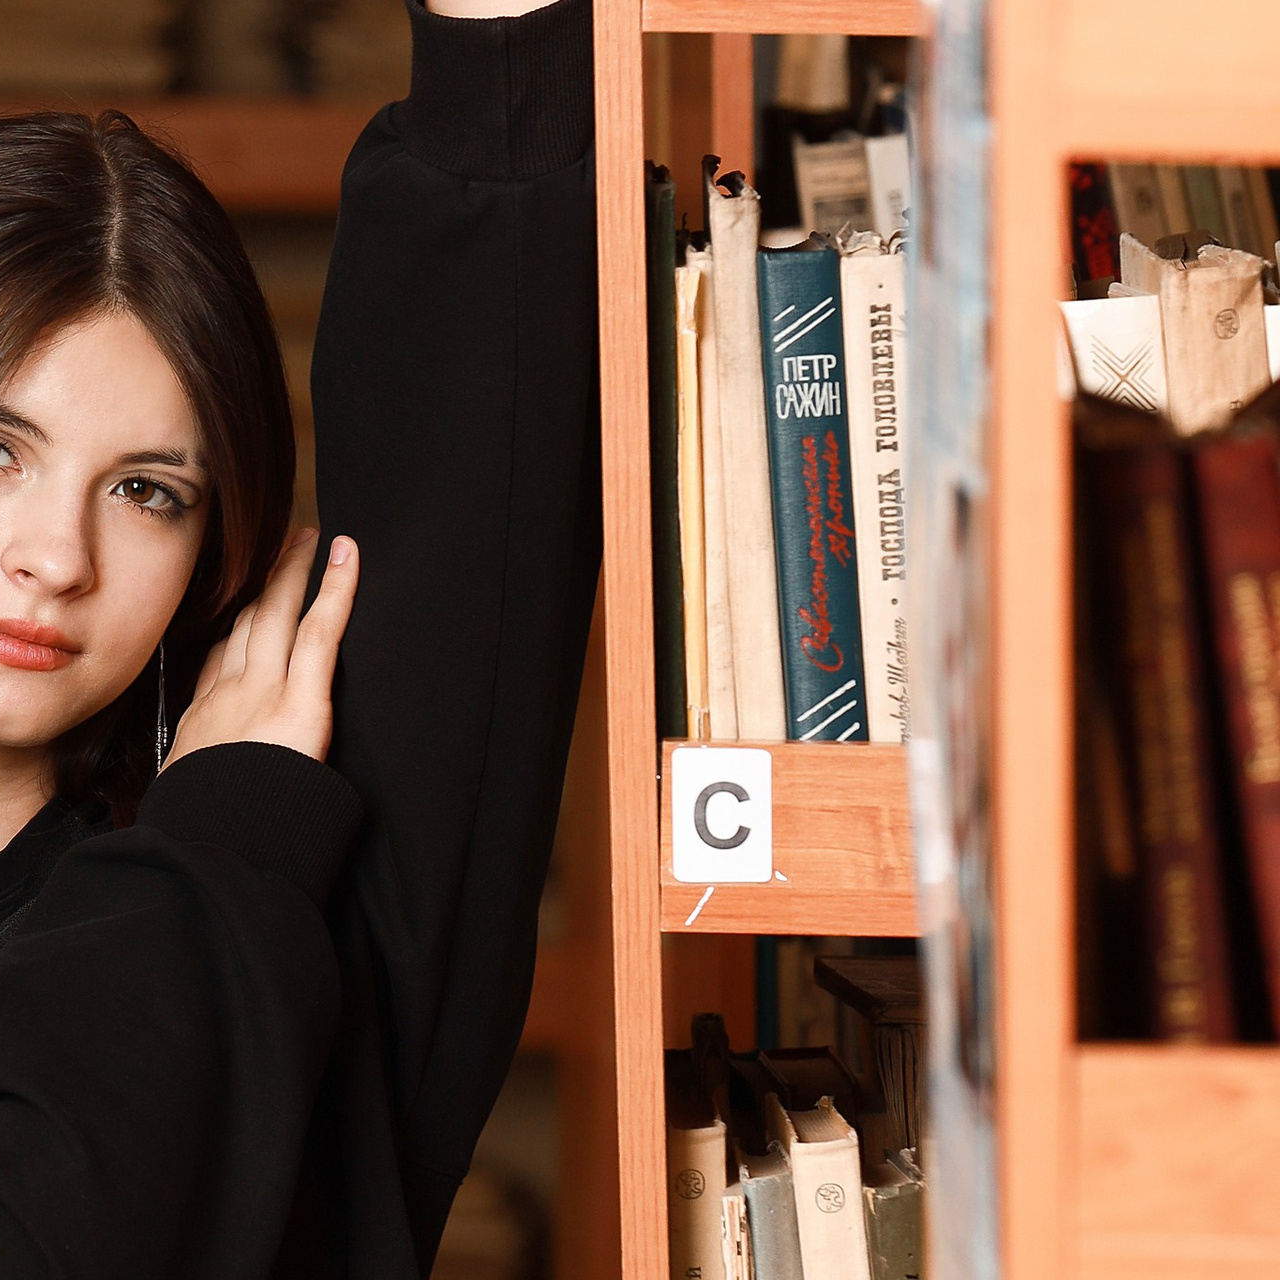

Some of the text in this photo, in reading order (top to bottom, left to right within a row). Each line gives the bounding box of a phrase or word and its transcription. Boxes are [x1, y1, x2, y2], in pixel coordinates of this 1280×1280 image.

[775, 381, 842, 420] САЖИН
[782, 353, 838, 382] ПЕТР
[870, 303, 899, 452] ГОЛОВЛЕВЫ
[797, 434, 844, 672] Севастопольская
[877, 468, 907, 582] ГОСПОДА
[693, 780, 752, 851] С
